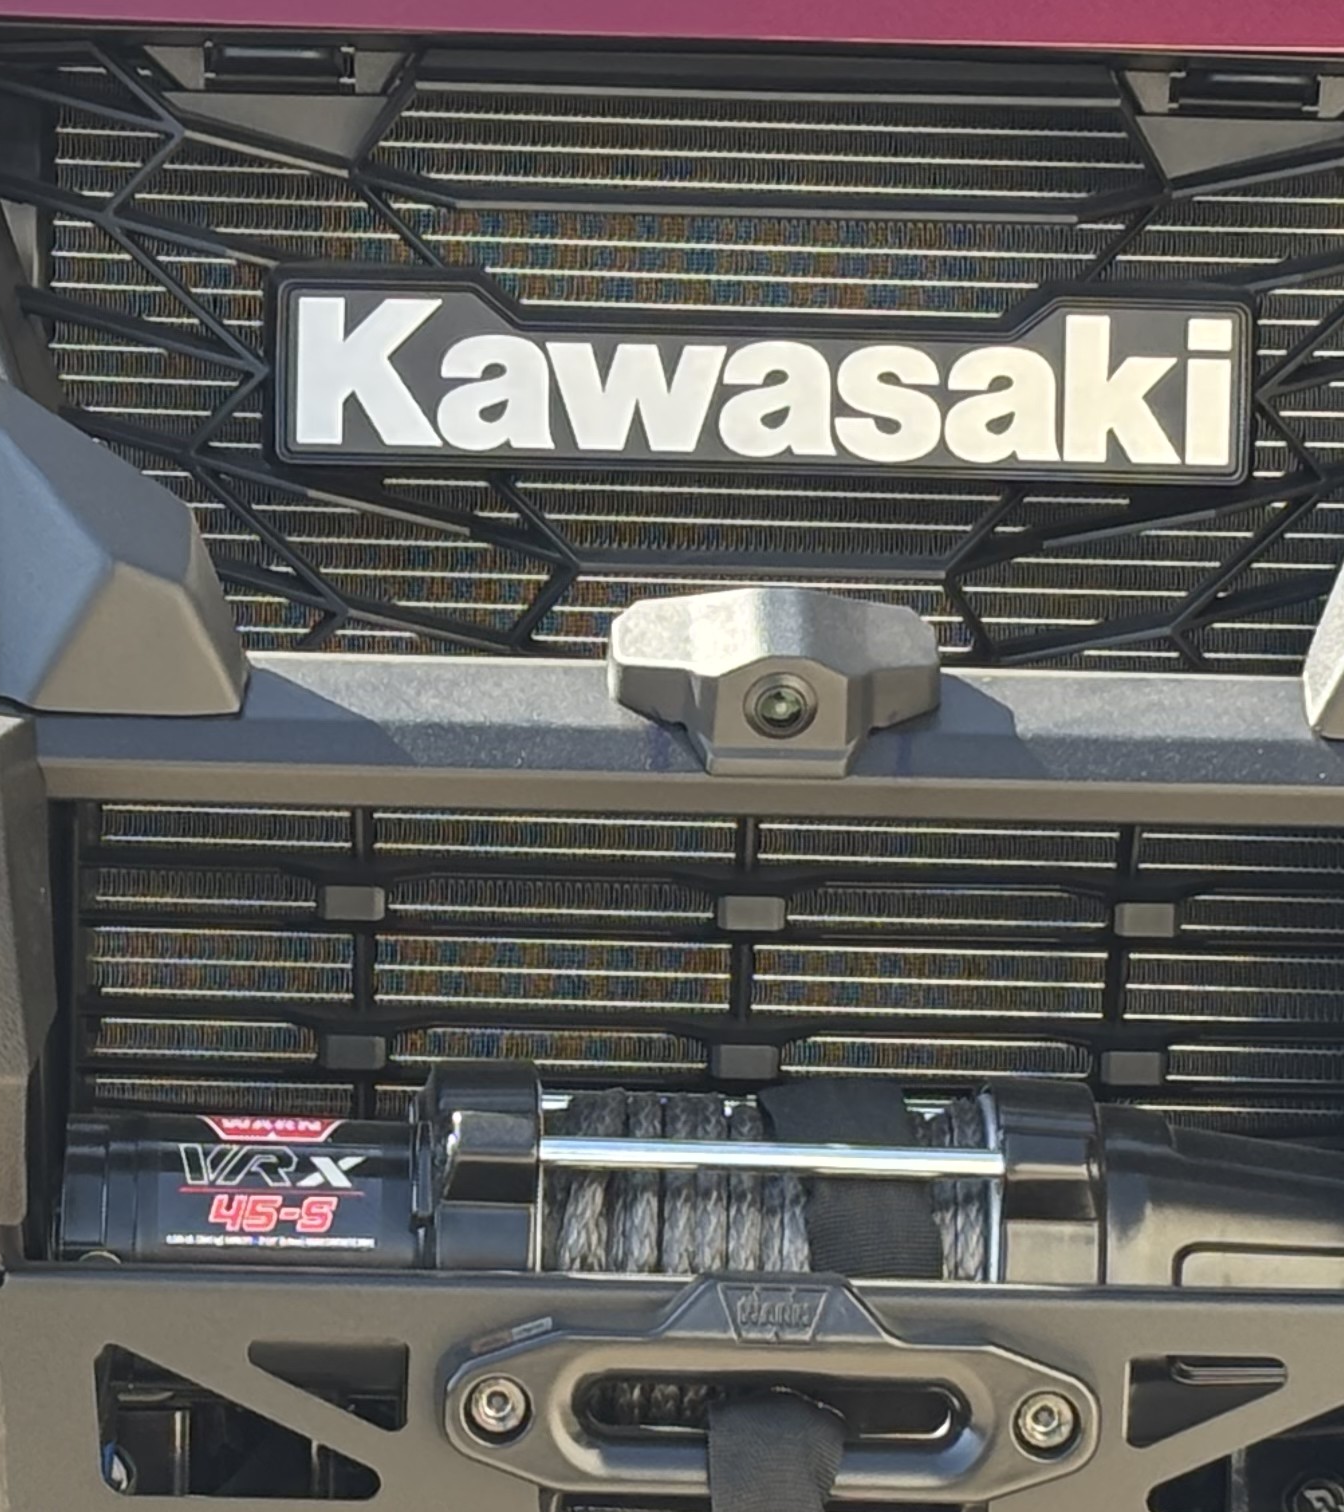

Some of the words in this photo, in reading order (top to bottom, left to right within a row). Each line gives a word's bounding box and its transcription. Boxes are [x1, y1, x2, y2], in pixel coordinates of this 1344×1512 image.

[296, 297, 1234, 466] Kawasaki
[221, 1119, 322, 1131] WARN
[178, 1143, 366, 1188] VRX
[208, 1194, 338, 1233] 45-S
